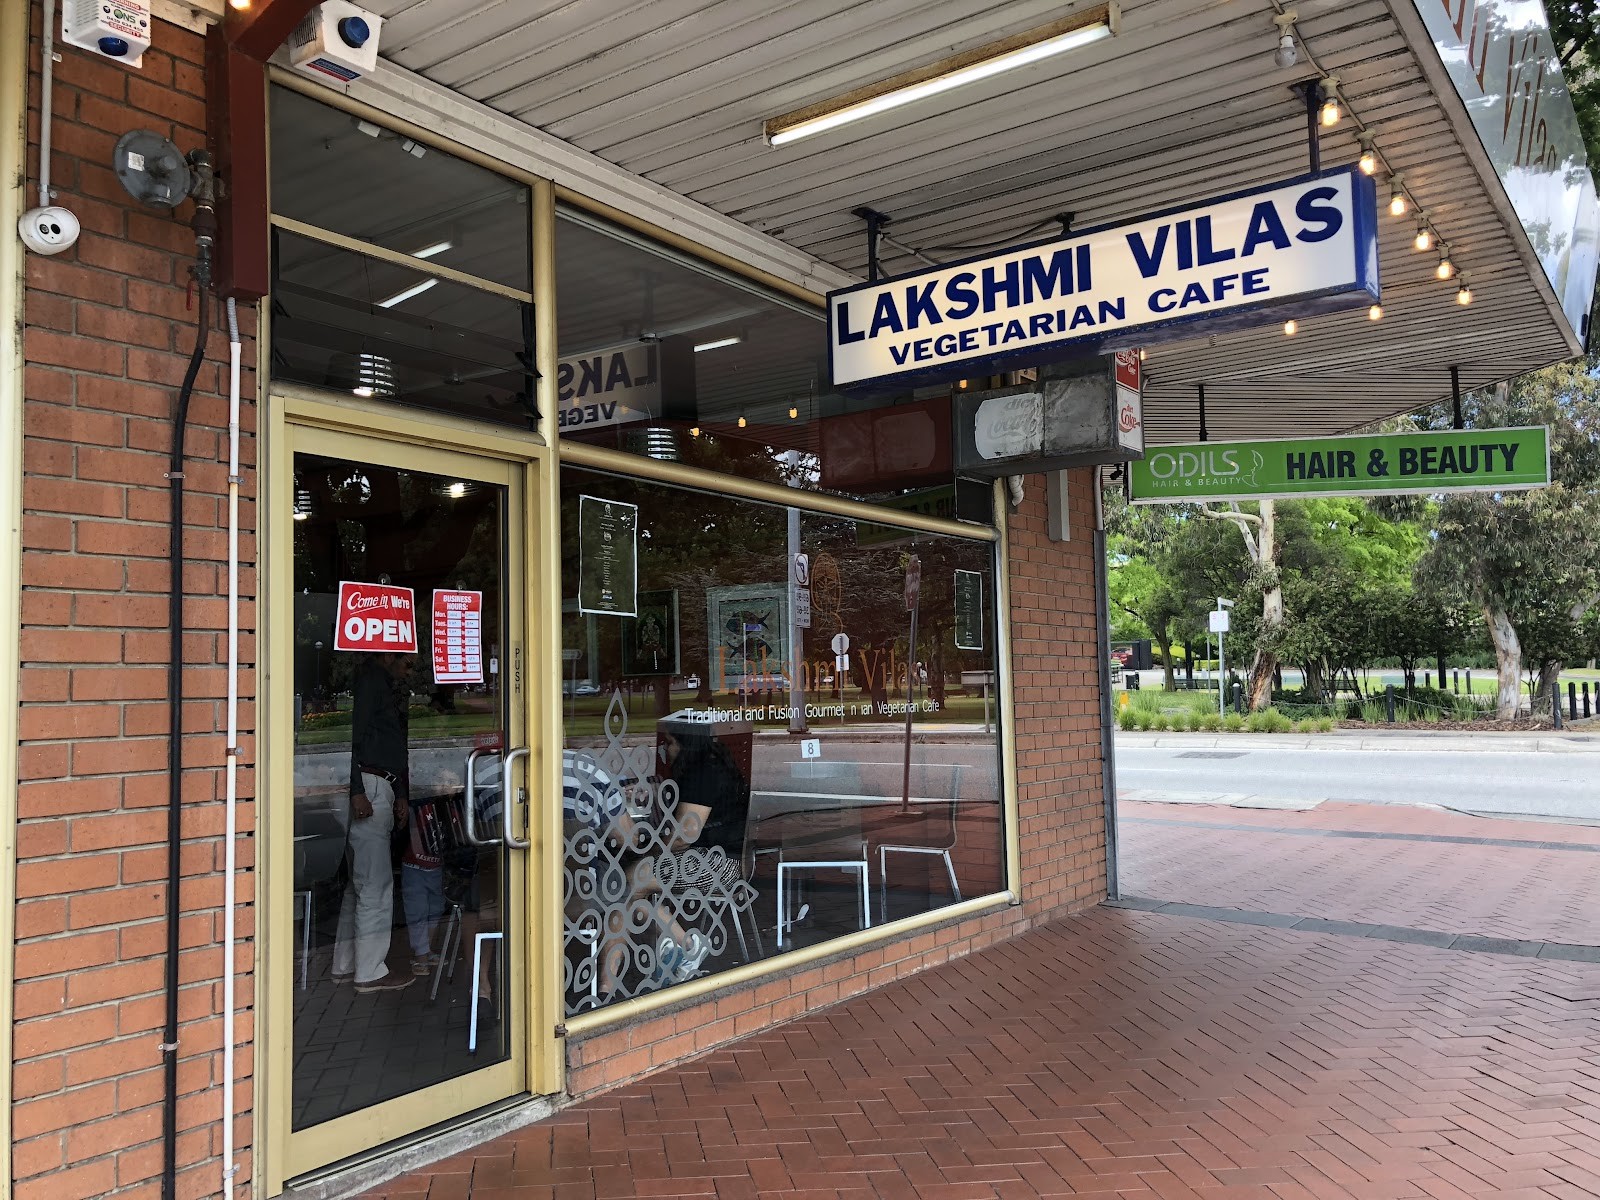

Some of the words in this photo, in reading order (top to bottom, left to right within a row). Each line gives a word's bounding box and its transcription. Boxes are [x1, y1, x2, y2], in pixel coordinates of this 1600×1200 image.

[837, 243, 1092, 346] LAKSHMI
[1125, 187, 1343, 279] VILAS
[889, 297, 1125, 366] VEGETARIAN
[1148, 267, 1270, 313] CAFE
[1150, 450, 1240, 478] ODILS
[1287, 450, 1357, 480] HAIR
[1366, 449, 1389, 477] &
[1399, 443, 1520, 475] BEAUTY
[1152, 480, 1179, 488] HAIR
[1185, 479, 1192, 487] &
[1198, 477, 1243, 486] BEAUTY
[347, 592, 379, 610] Come
[380, 594, 388, 610] in
[391, 595, 410, 610] We're
[443, 595, 472, 603] BUSINESS
[447, 602, 469, 610] HOURS:
[344, 616, 413, 644] OPEN
[685, 706, 743, 724] Traditional
[745, 704, 764, 720] and
[769, 704, 800, 720] Fusion
[804, 703, 845, 718] Gourmet
[877, 700, 919, 717] Vegetarian
[922, 698, 940, 713] Cafe
[807, 742, 814, 755] 8
